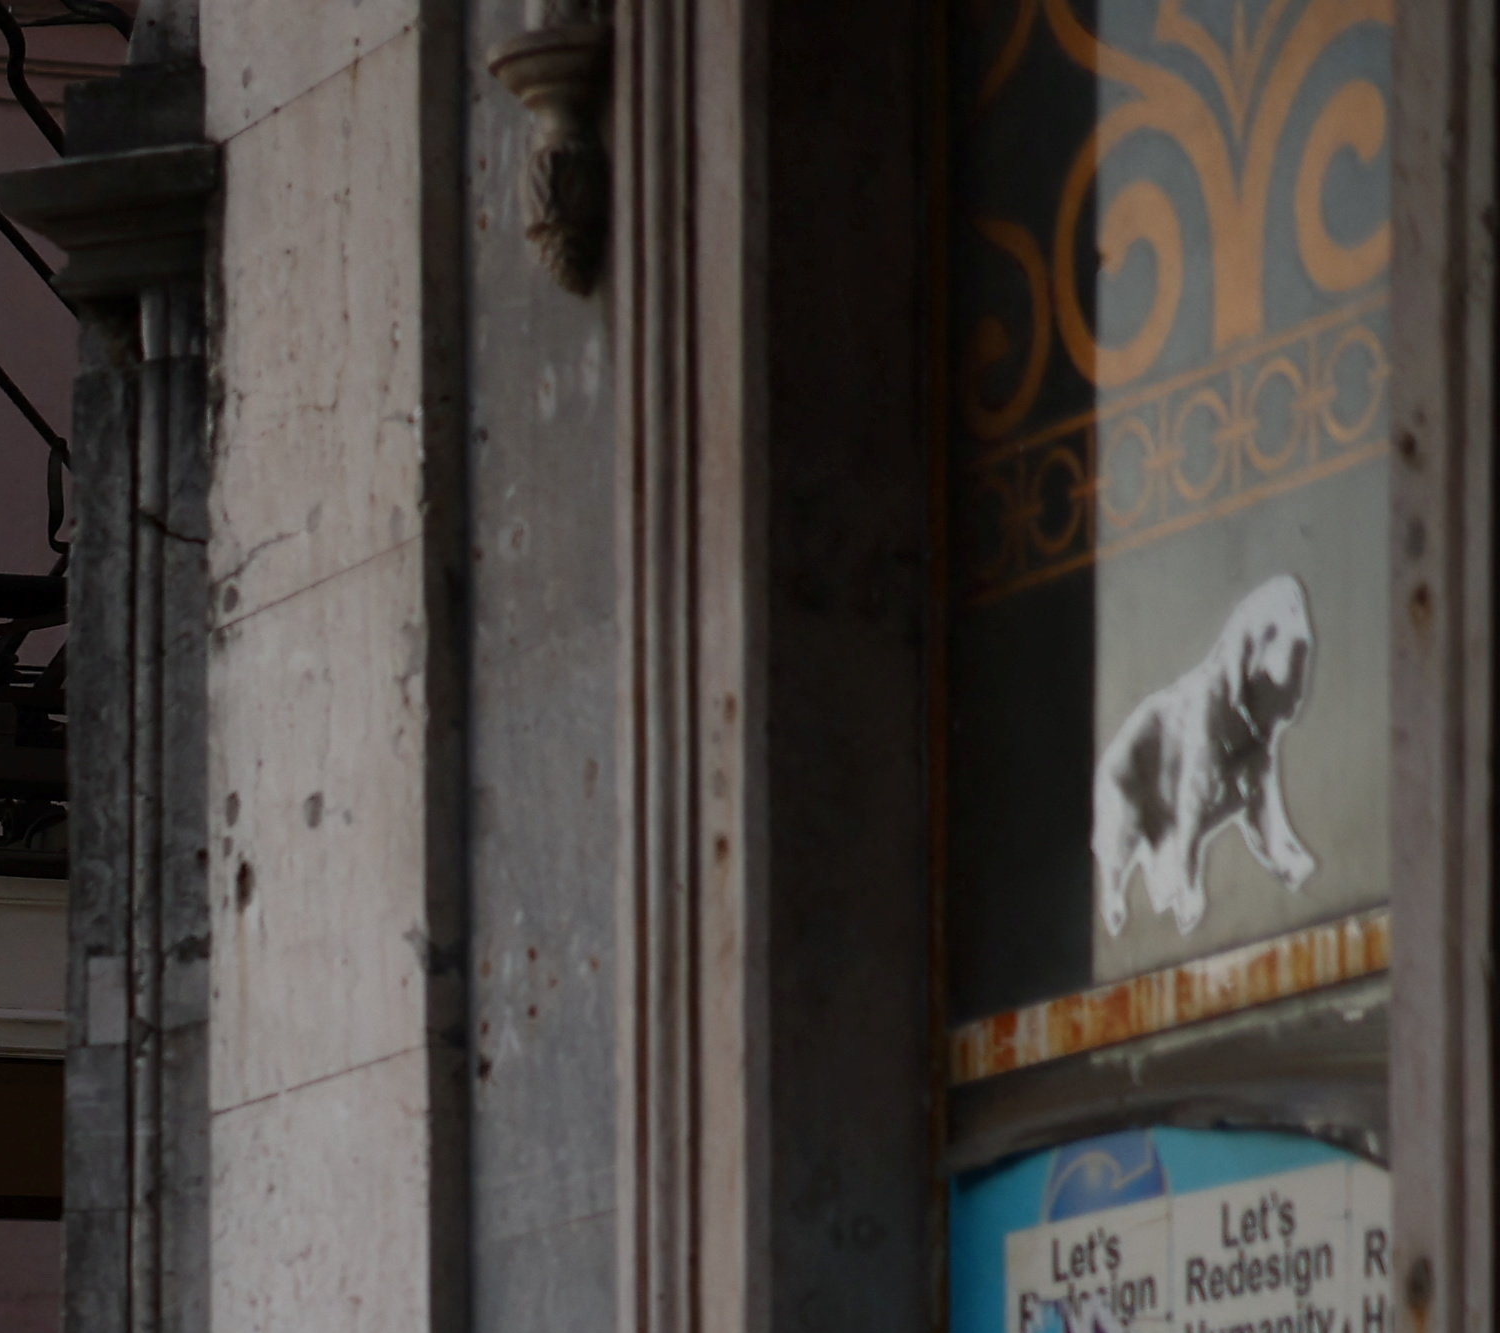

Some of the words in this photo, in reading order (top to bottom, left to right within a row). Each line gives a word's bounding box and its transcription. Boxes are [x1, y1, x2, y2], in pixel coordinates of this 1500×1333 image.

[1220, 1189, 1297, 1249] Let's
[1051, 1227, 1121, 1285] Let's
[1185, 1241, 1334, 1305] Redesign
